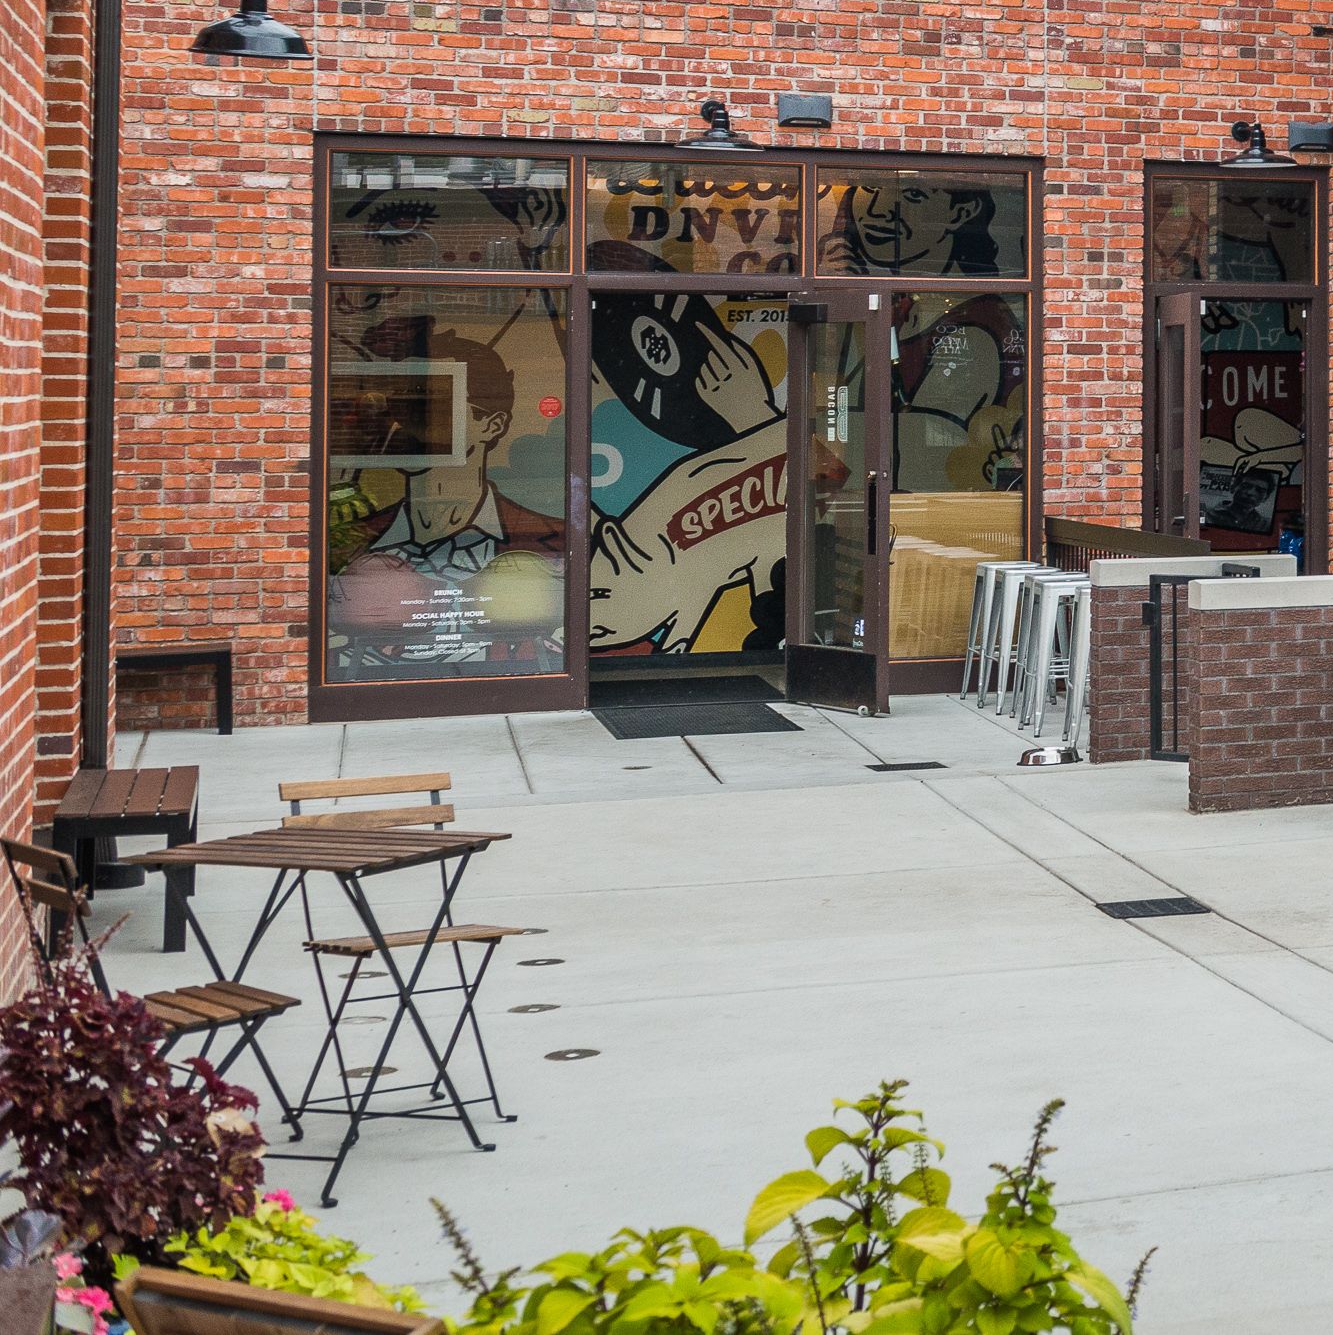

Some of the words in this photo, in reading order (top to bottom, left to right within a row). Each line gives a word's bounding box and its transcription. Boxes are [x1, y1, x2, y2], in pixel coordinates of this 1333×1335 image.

[727, 310, 755, 323] EST.
[759, 310, 789, 323] 201
[412, 612, 439, 620] SOCIAL
[440, 611, 463, 619] HAPPY
